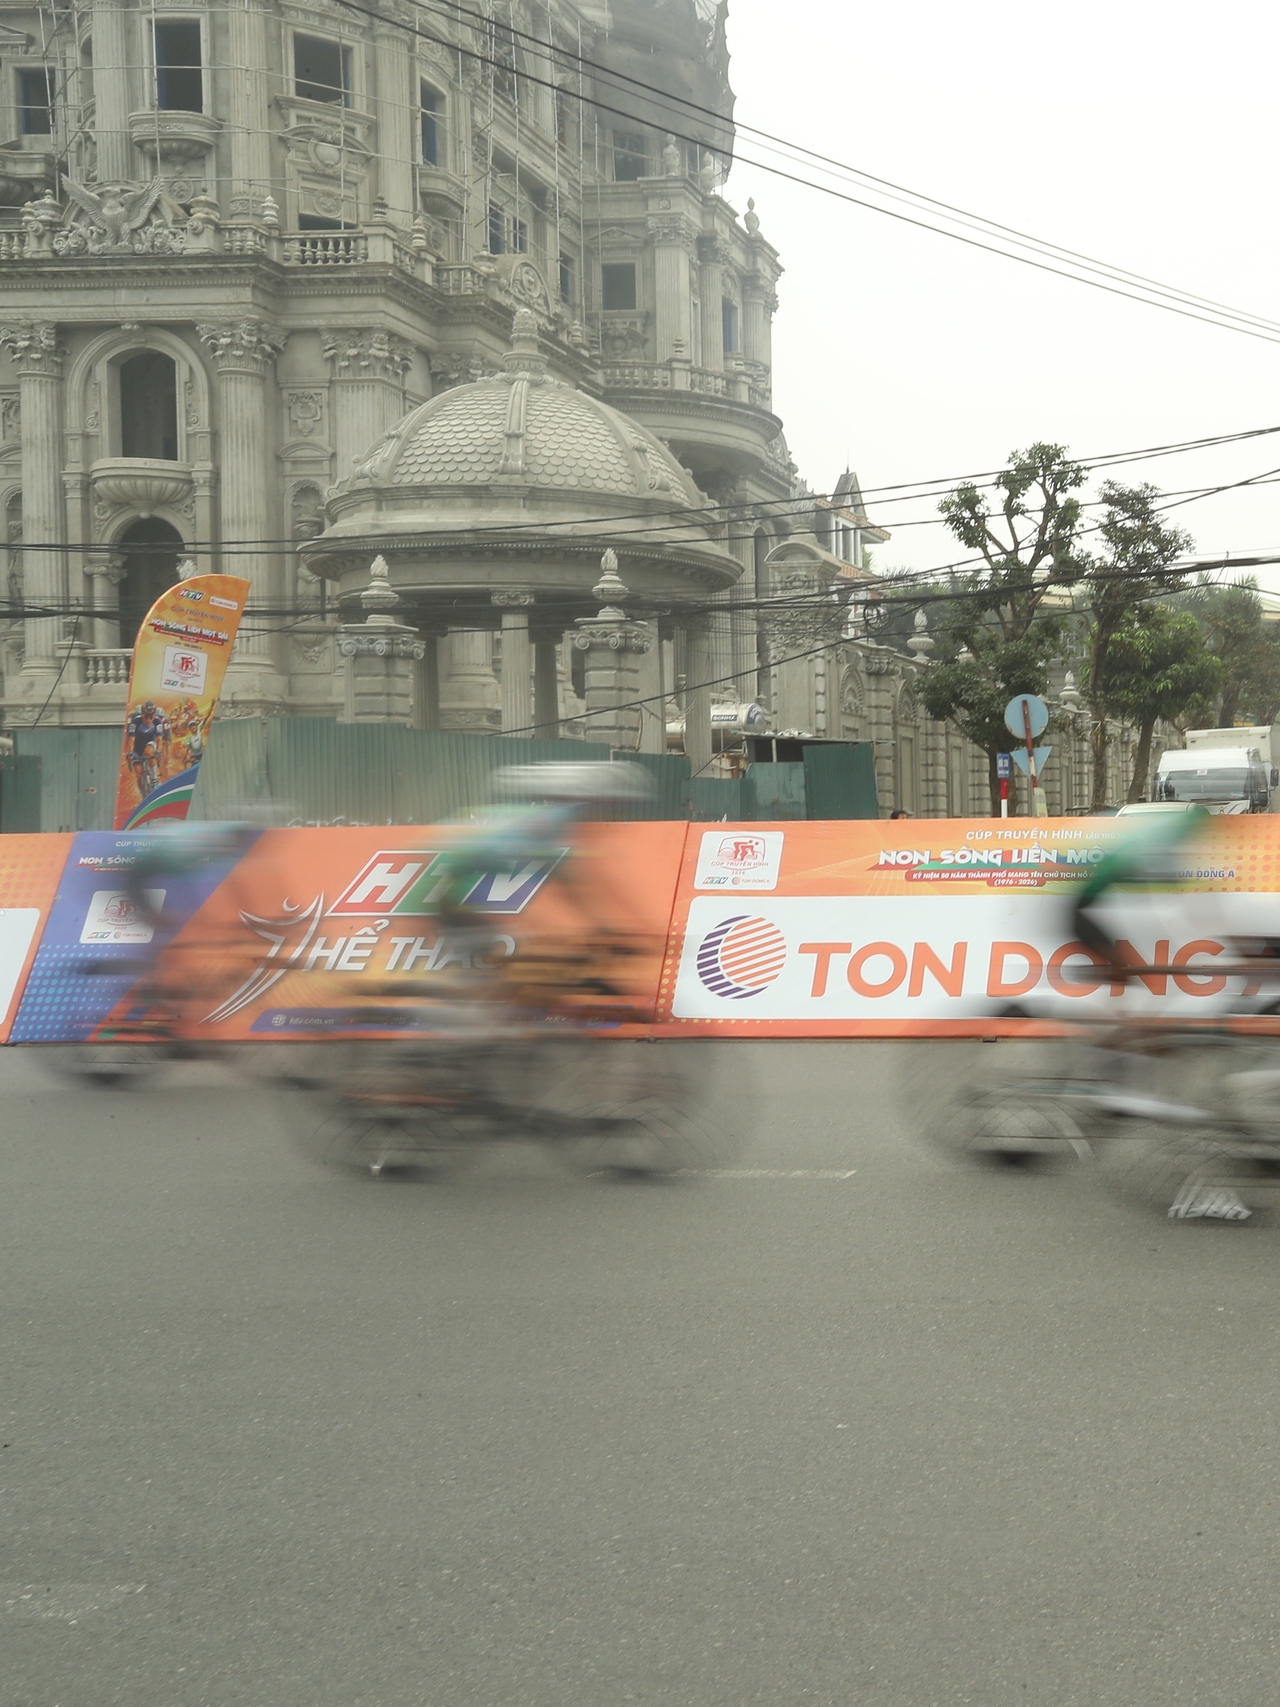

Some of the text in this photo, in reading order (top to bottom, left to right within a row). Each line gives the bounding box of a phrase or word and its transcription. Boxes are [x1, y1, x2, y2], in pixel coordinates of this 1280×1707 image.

[179, 589, 203, 600] HTV
[966, 829, 993, 840] CÚP
[996, 827, 1048, 840] TRUYỀN
[1051, 828, 1082, 840] HÌNH
[79, 855, 136, 865] NON SÔNG
[879, 841, 1108, 868] NON SÔNG LIỀN MỘ
[703, 876, 729, 885] HTV
[941, 871, 949, 879] 50
[1007, 871, 1029, 879] MANG
[1060, 871, 1076, 879] TỊCH
[1018, 878, 1038, 886] 2026)
[385, 934, 517, 971] THAO
[797, 940, 968, 999] TON
[986, 939, 1227, 998] DONG
